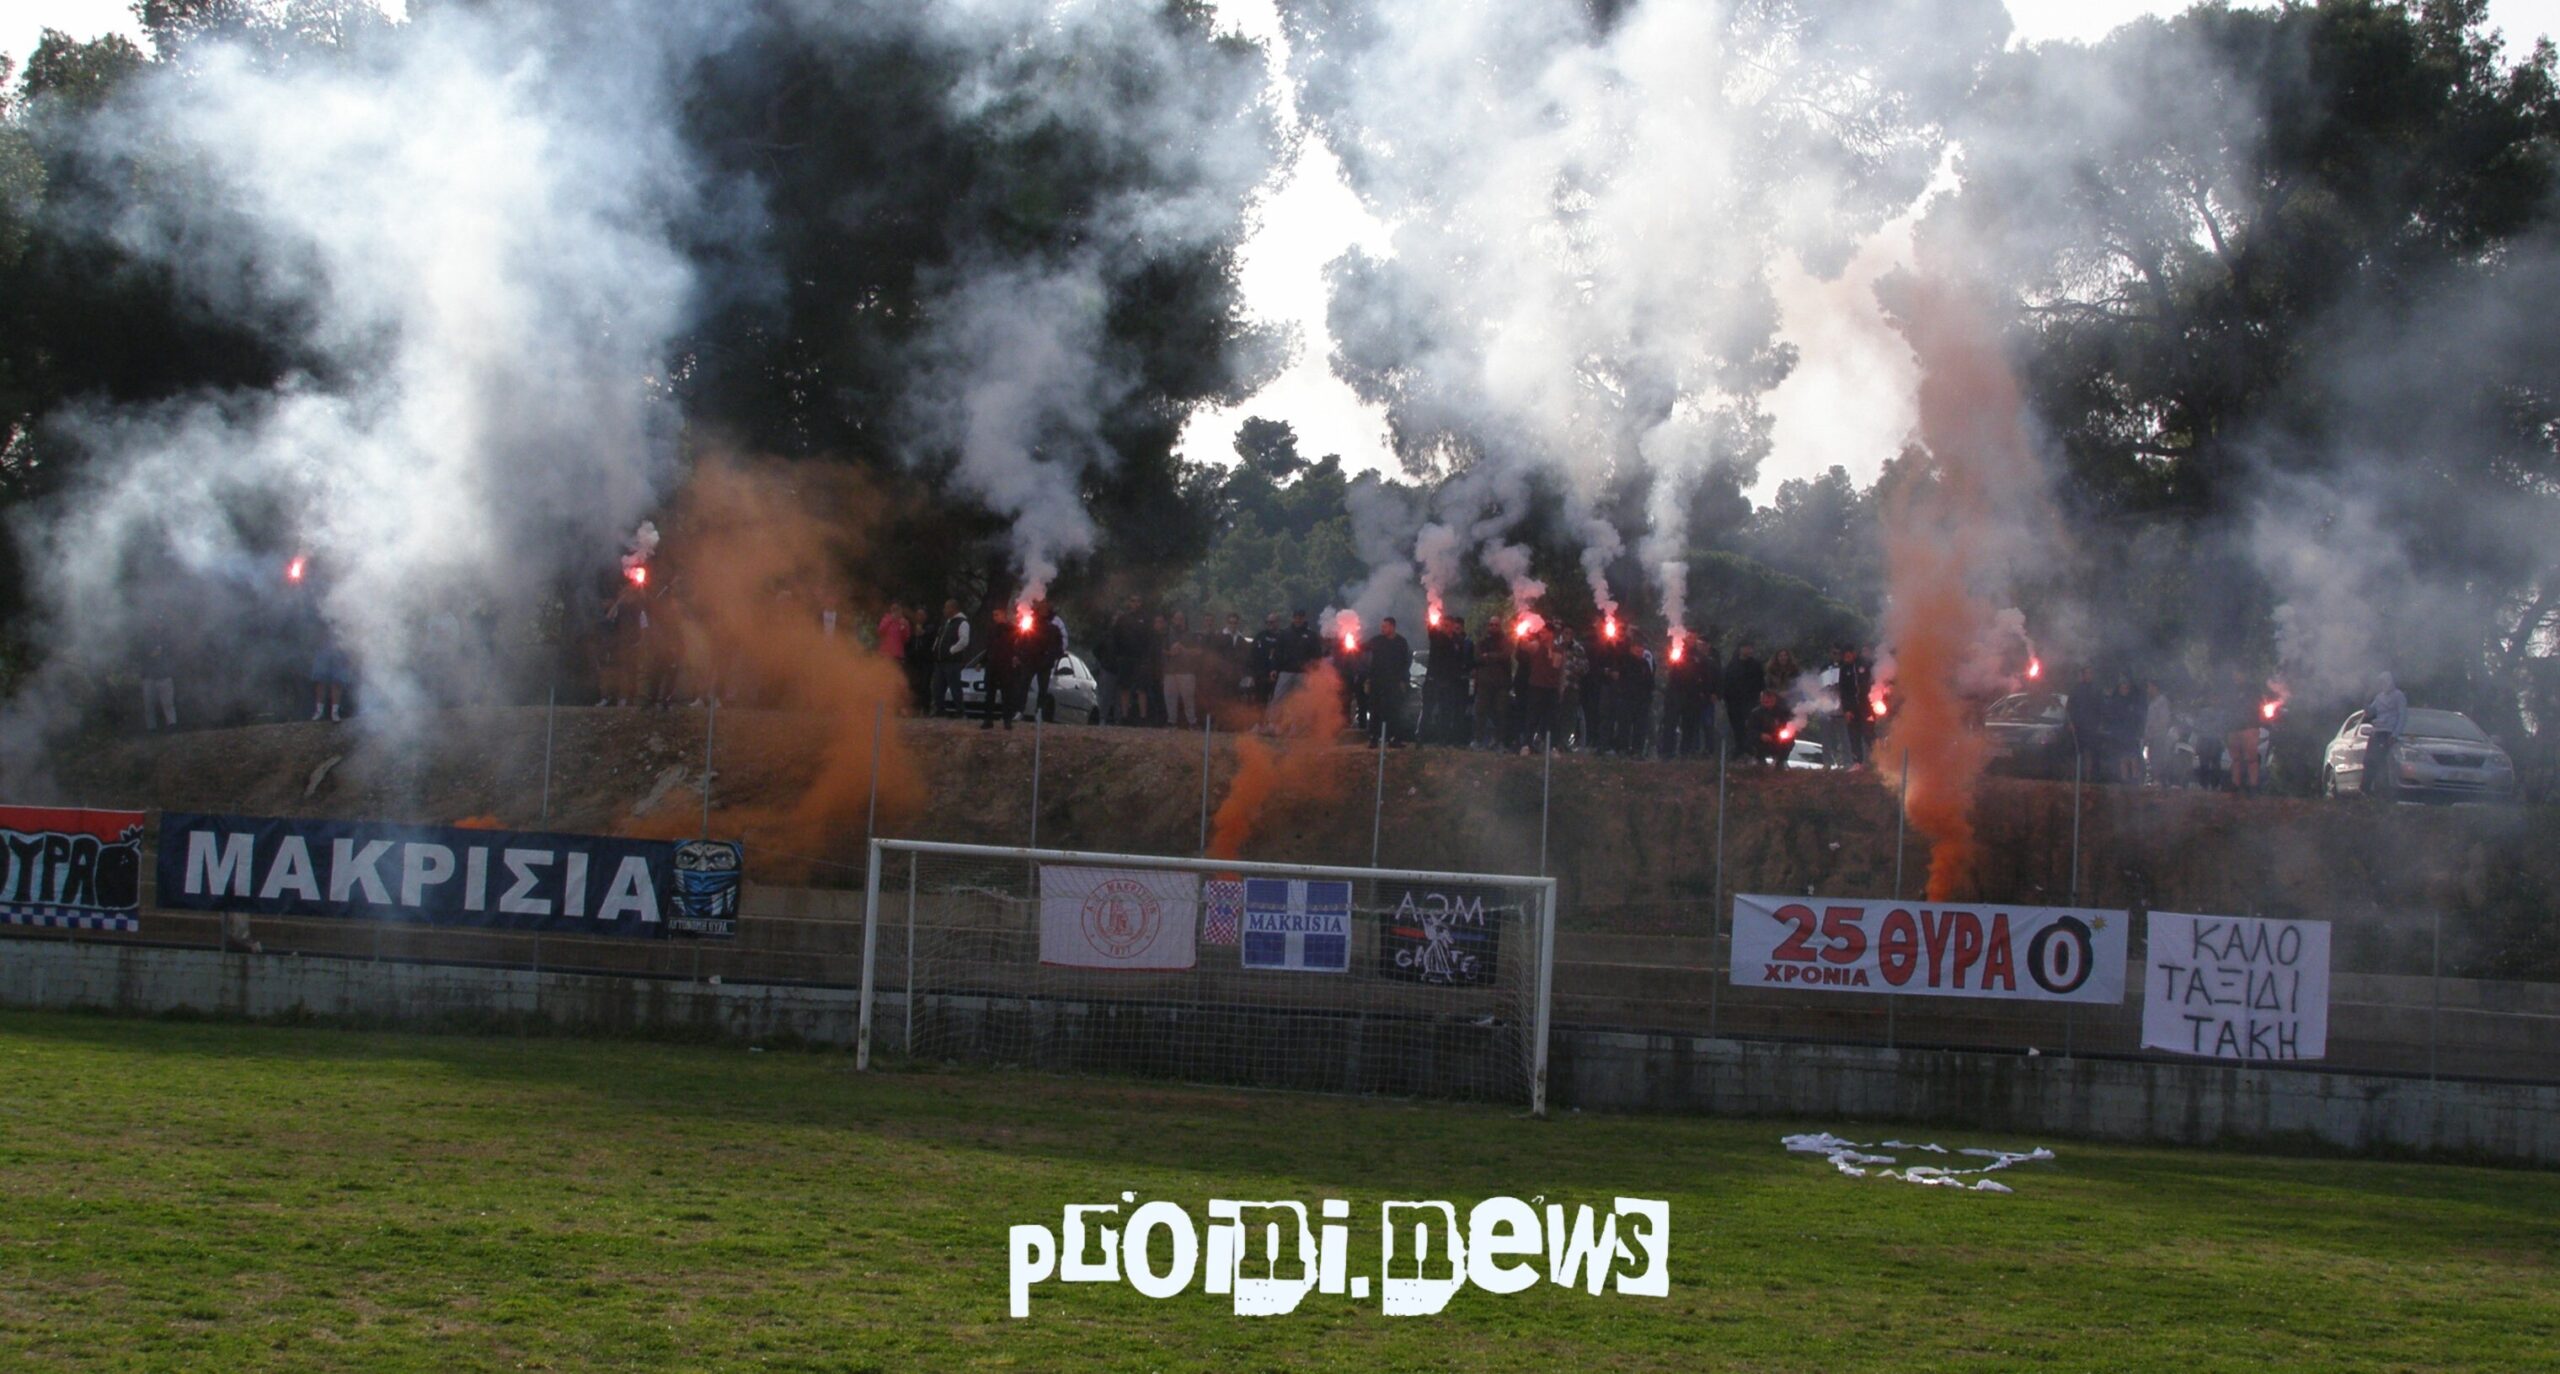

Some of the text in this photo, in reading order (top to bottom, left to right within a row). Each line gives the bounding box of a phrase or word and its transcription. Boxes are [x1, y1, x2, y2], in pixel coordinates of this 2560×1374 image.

[183, 829, 662, 923] ΜΑΚΡΙΣΙΑ
[1249, 913, 1343, 932] MAKRISIA
[2193, 918, 2301, 966] ΚΑΛΟ
[1771, 904, 1867, 965] 25
[1878, 908, 2017, 991] ΘΥΡΑ
[1763, 963, 1870, 987] ΧΡΟΝΙΑ
[2158, 964, 2299, 1014] ΤΑΞΙΔΙ
[2183, 1014, 2298, 1060] ΤΑΚΗ
